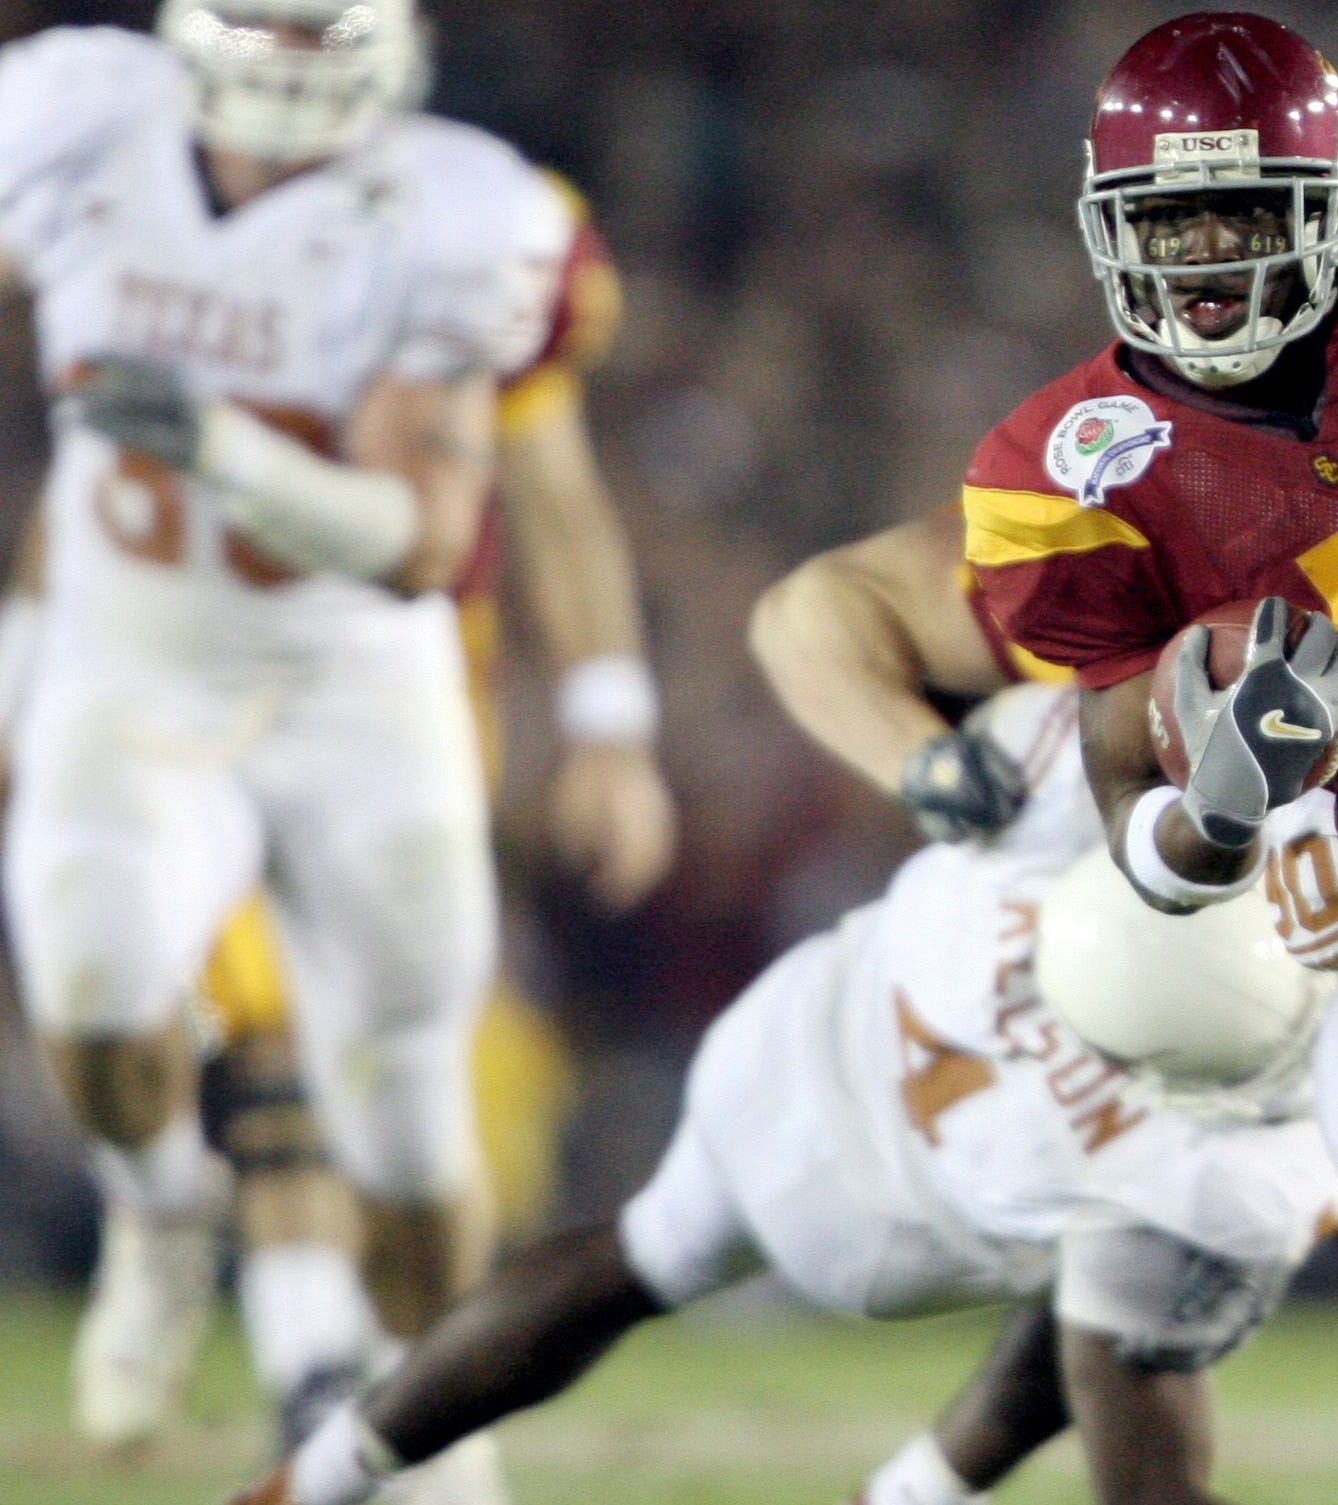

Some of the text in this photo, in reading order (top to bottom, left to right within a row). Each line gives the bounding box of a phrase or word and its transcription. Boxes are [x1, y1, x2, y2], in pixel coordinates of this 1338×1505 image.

[1181, 136, 1233, 152] USC
[1147, 236, 1181, 258] 619
[1250, 232, 1287, 254] 619
[1057, 405, 1093, 438] BOWL
[1053, 441, 1072, 476] ROSE
